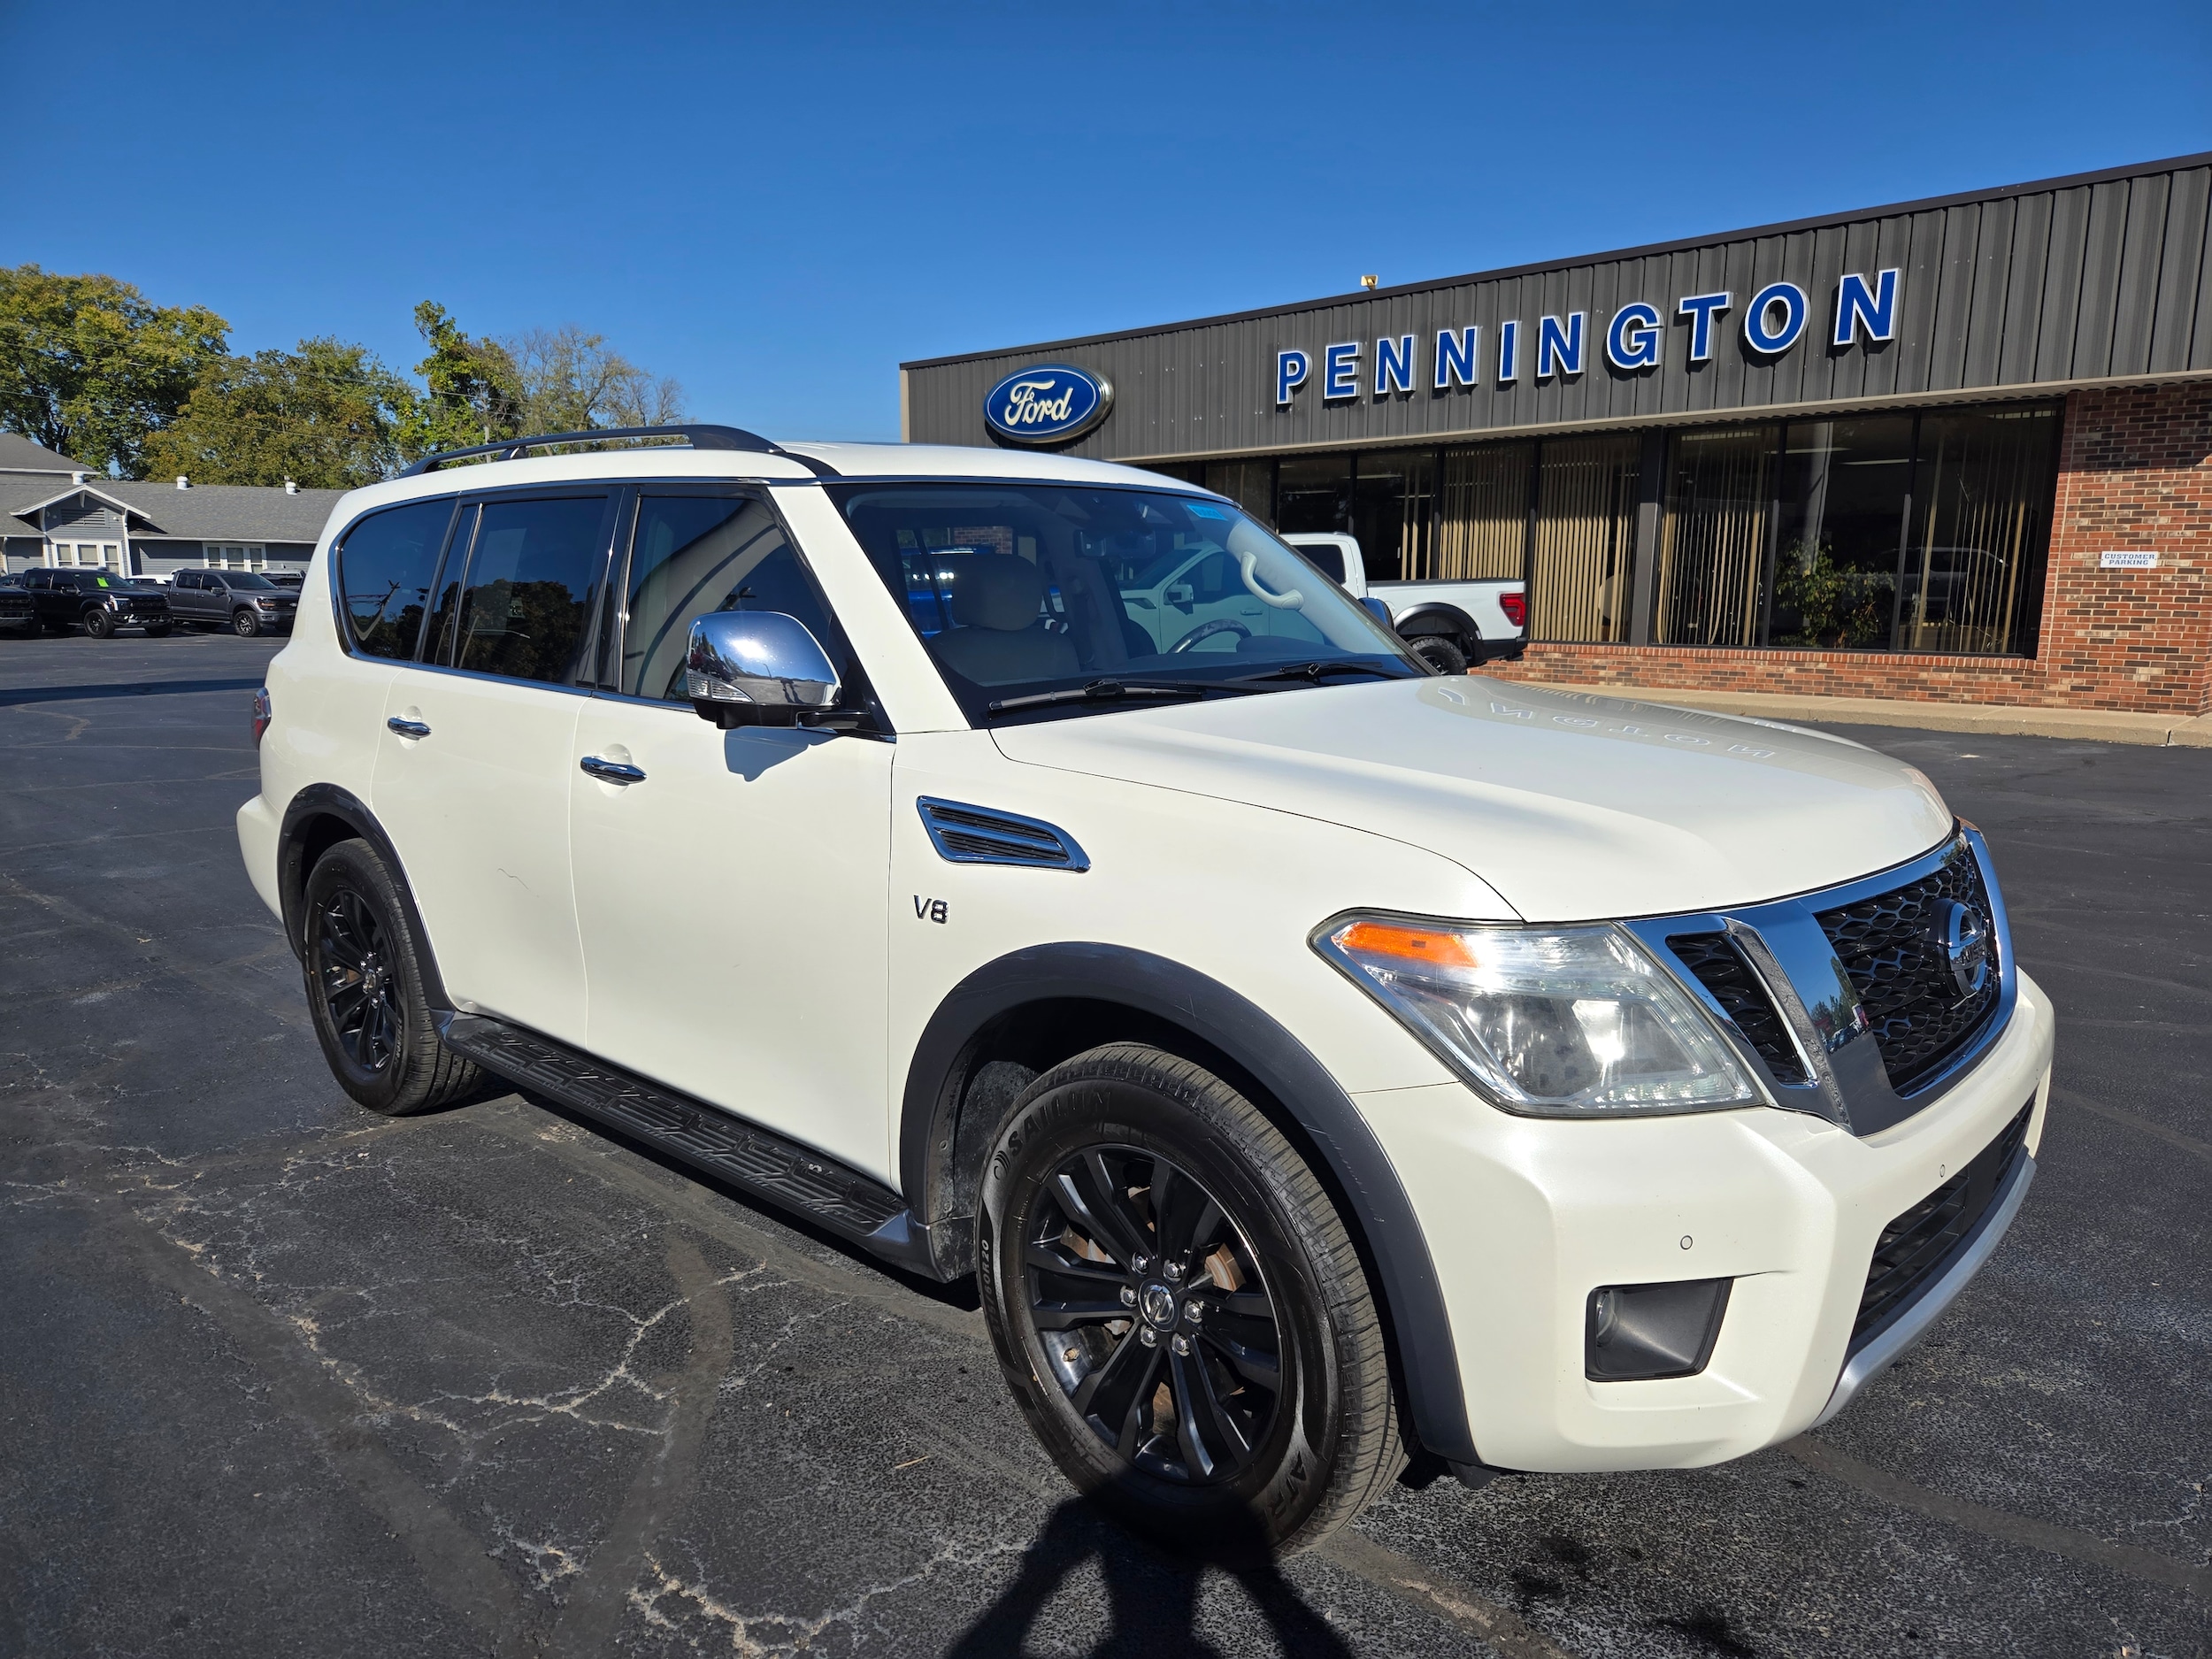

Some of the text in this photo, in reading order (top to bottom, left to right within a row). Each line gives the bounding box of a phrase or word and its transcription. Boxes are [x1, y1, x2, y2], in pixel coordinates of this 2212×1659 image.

[1277, 268, 1901, 405] PENNINGTON
[1004, 380, 1073, 426] Ford
[913, 894, 949, 924] V8
